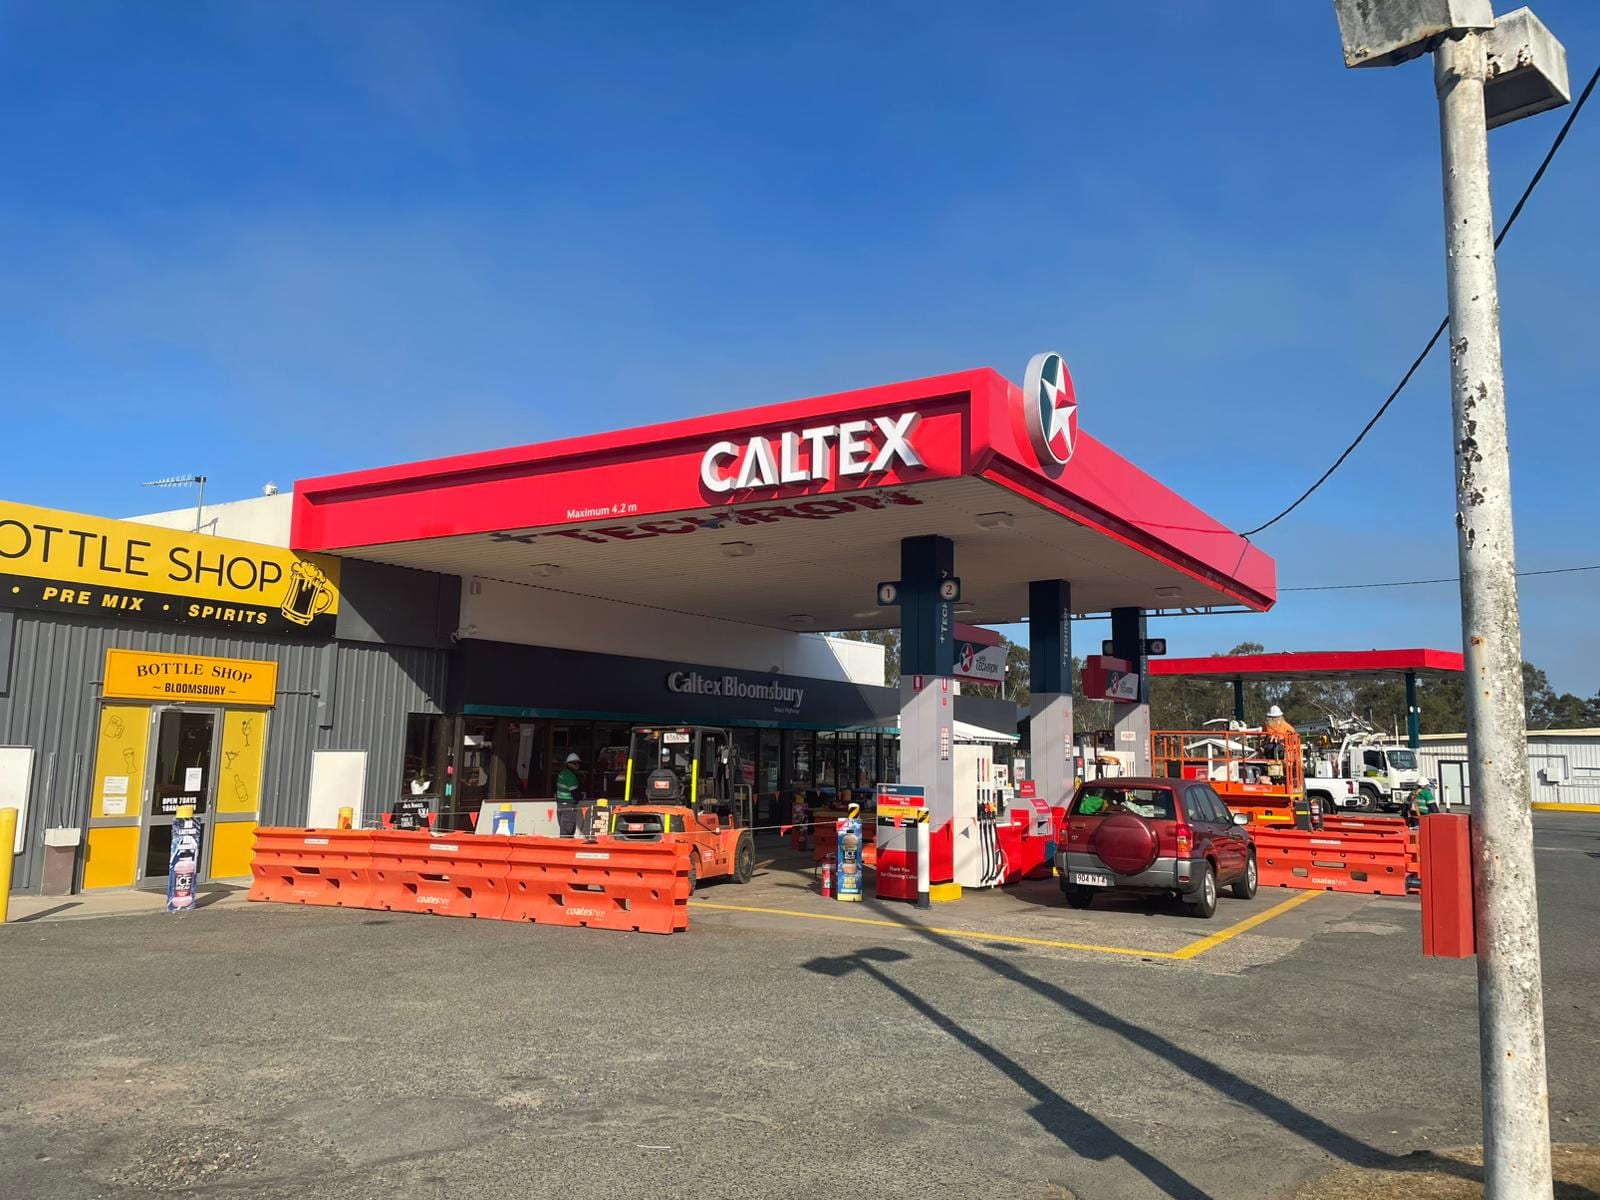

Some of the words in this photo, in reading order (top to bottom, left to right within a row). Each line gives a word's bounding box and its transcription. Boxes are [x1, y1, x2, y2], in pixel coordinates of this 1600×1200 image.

[701, 411, 924, 493] CALTEX
[566, 505, 610, 519] Maximum
[611, 503, 626, 514] 4.2
[628, 503, 637, 512] m
[168, 546, 283, 592] SHOP
[885, 588, 891, 599] 1
[945, 584, 953, 595] 2
[42, 586, 90, 605] PRE
[101, 594, 145, 611] MIX
[188, 604, 269, 625] SPIRITS
[137, 662, 204, 678] BOTTLE
[211, 666, 252, 683] SHOP
[164, 682, 226, 696] BLOOMSBURY
[162, 797, 178, 805] OPEN
